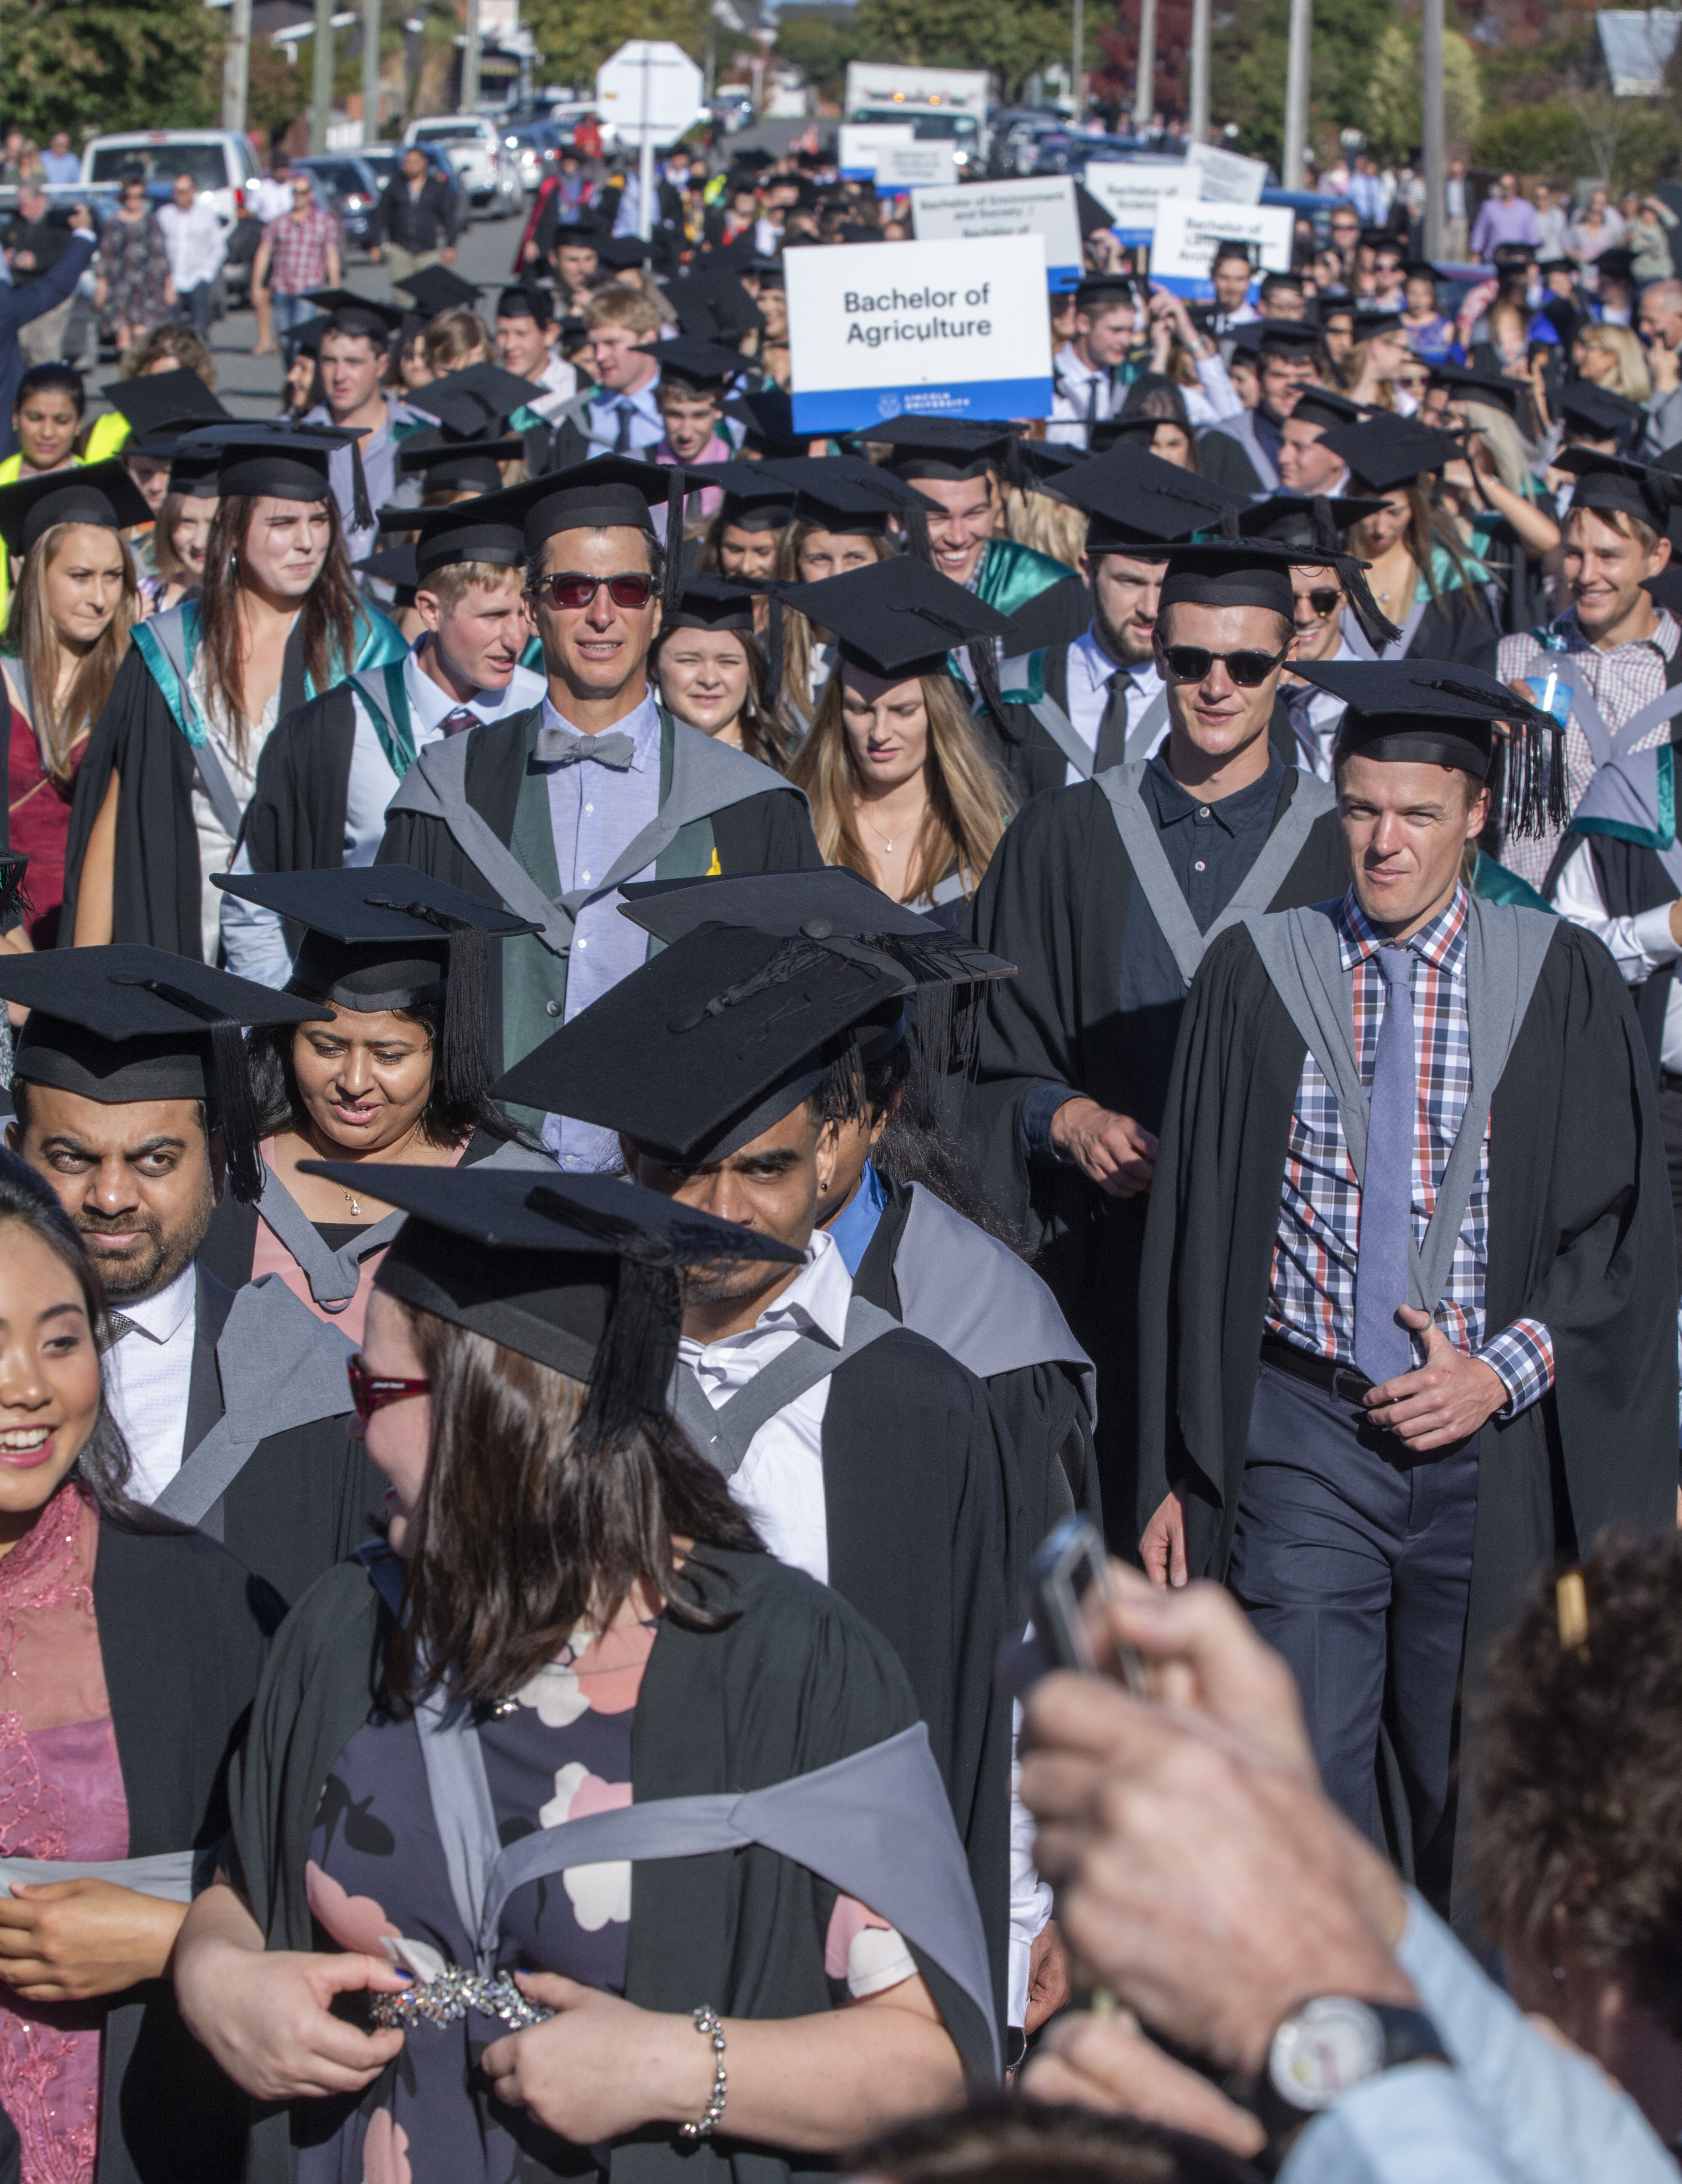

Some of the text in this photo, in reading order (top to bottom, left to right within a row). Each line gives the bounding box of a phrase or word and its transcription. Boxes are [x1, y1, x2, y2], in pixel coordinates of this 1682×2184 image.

[1106, 184, 1178, 196] Bachelor of
[921, 191, 1065, 209] Bachelor of Environment
[954, 210, 976, 220] and
[979, 207, 1023, 219] Society
[963, 224, 1029, 238] Bachelor of
[1185, 217, 1262, 235] Bachelor of
[844, 282, 989, 312] Bachelor of
[847, 316, 992, 347] Agriculture
